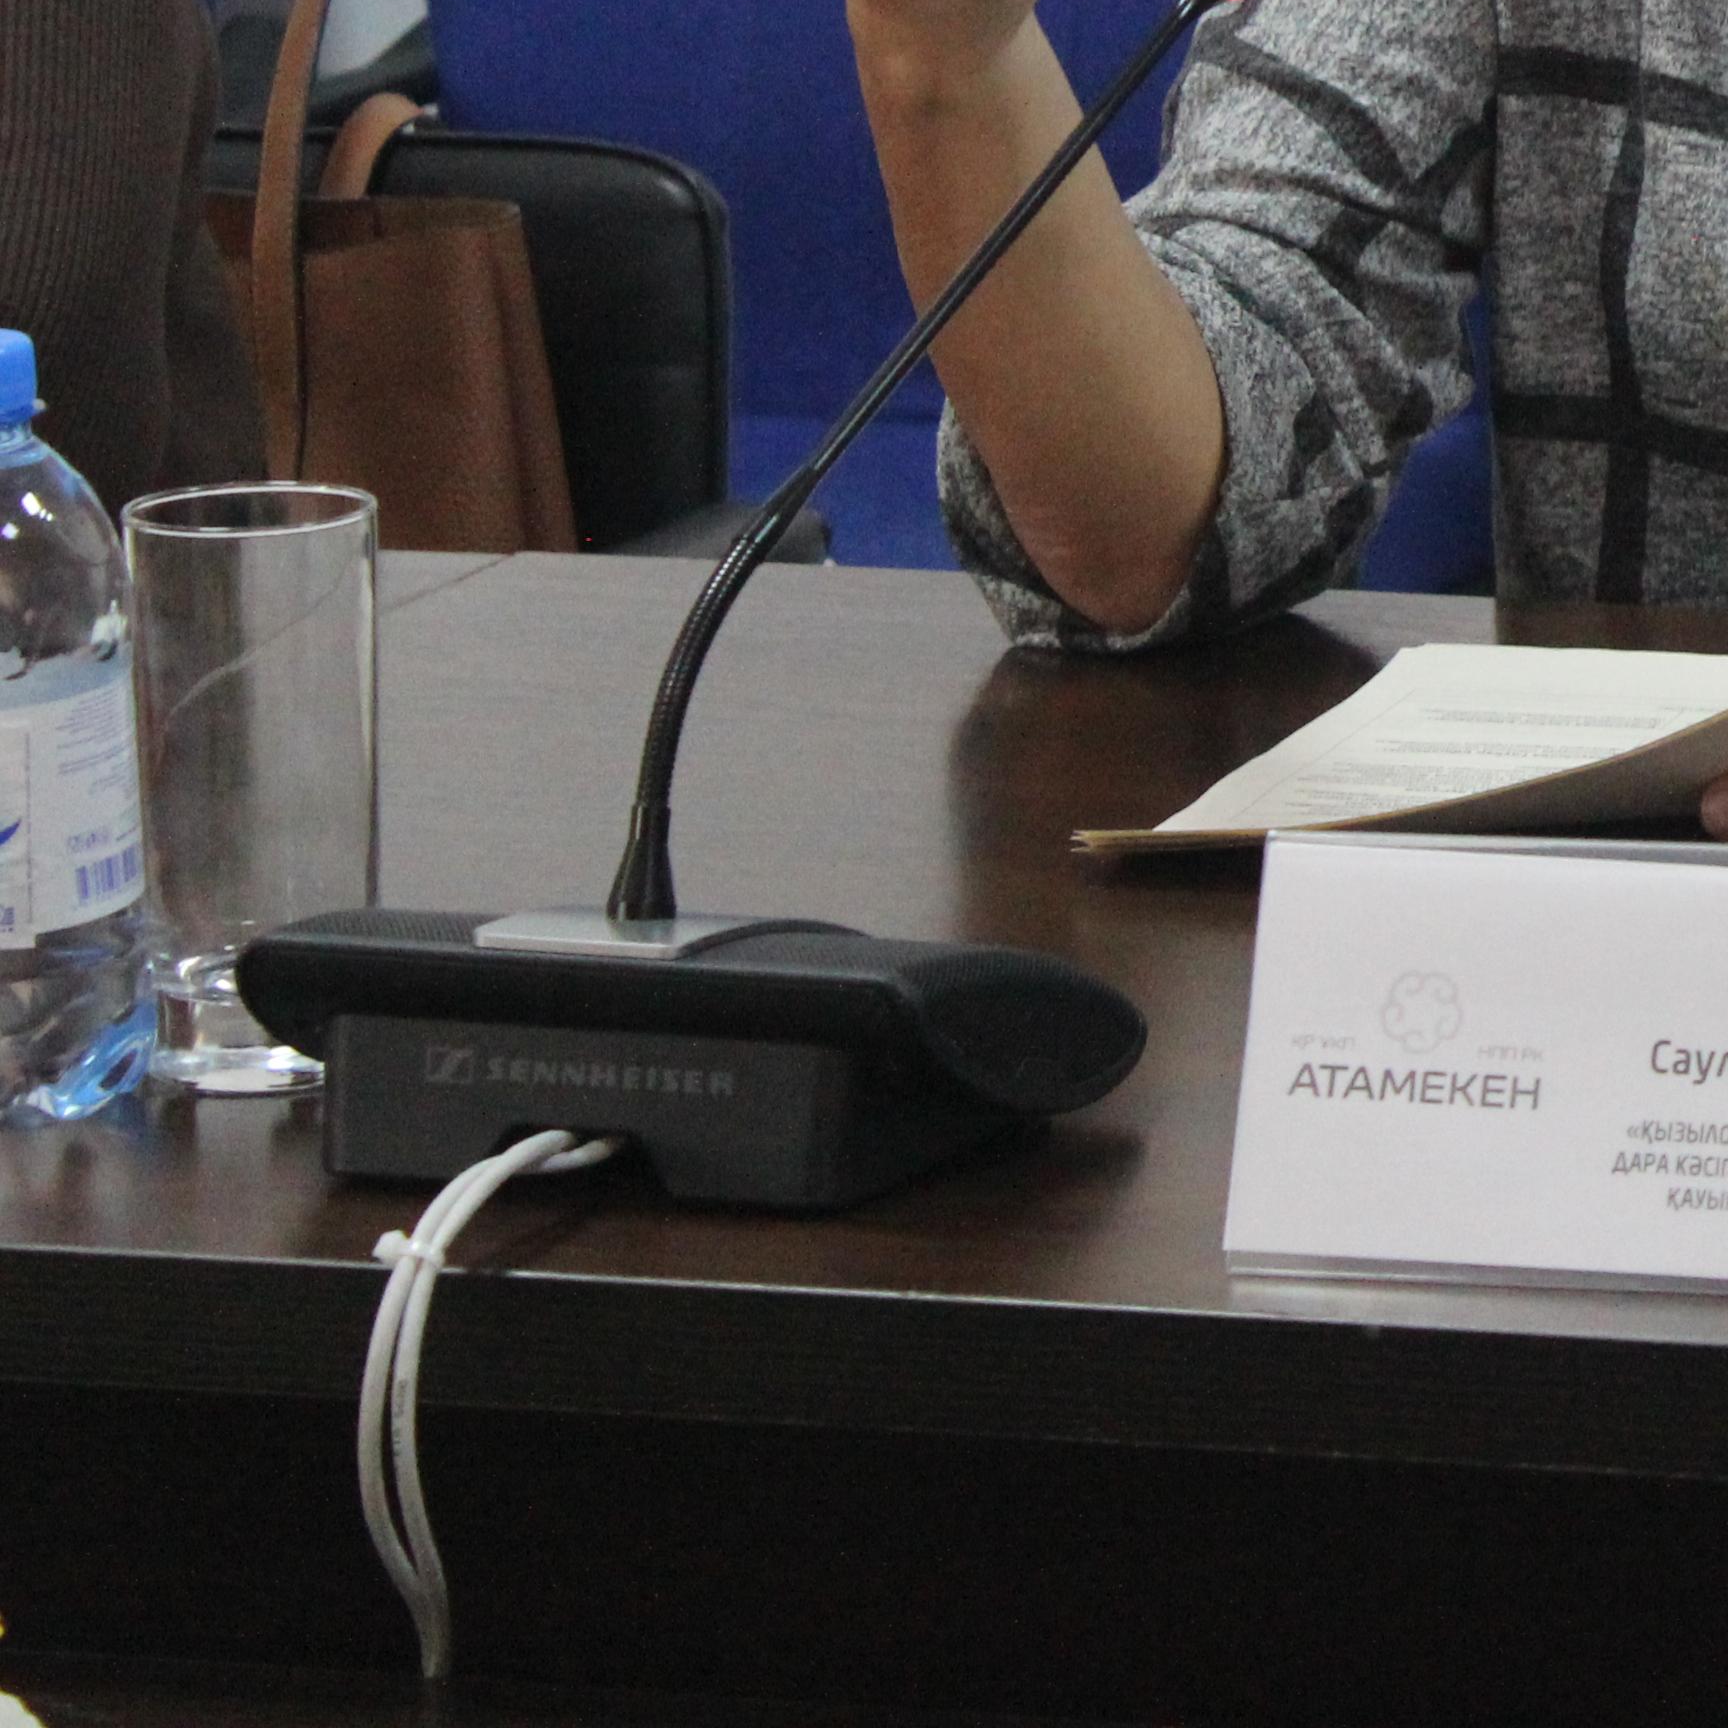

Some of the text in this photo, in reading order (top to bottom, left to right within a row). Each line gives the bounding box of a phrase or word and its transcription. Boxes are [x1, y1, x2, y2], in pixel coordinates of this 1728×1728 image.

[486, 1056, 735, 1096] SENNHEISER
[1288, 1062, 1542, 1110] АТАМЕКЕН
[1612, 1151, 1669, 1175] ДАРА
